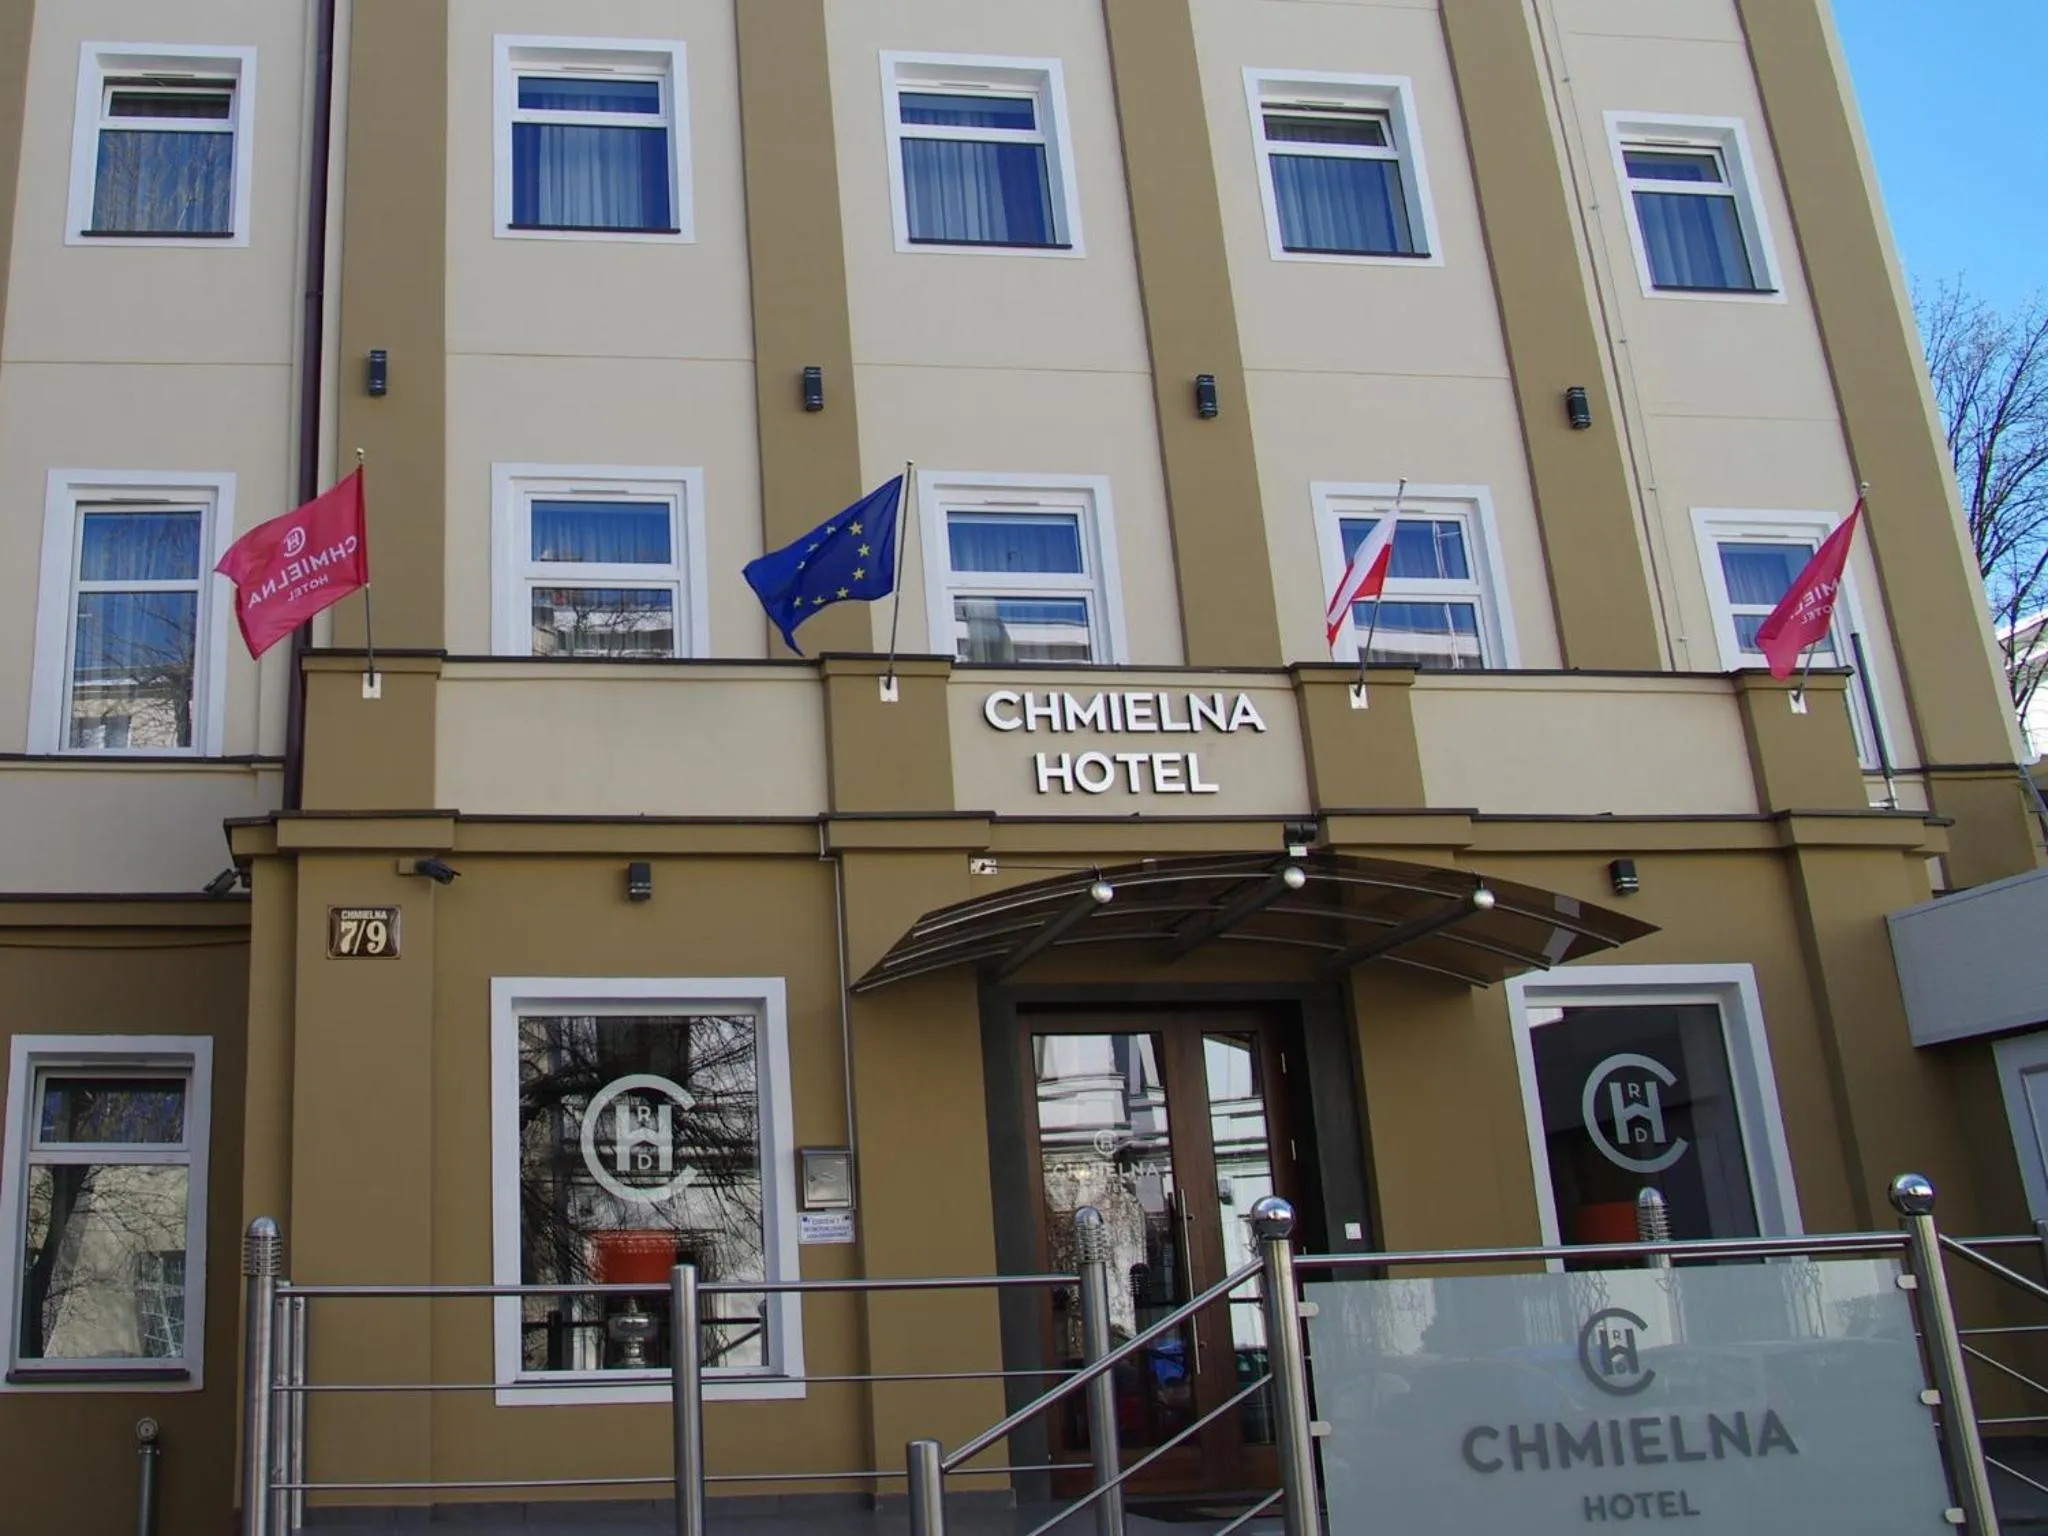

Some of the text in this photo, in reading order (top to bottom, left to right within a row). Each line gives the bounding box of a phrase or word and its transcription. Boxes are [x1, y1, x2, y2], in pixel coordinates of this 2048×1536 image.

[984, 690, 1267, 732] CHMIELNA
[1034, 751, 1220, 794] HOTEL
[340, 920, 387, 954] 7/9
[1461, 1408, 1799, 1474] CHMIELNA
[1582, 1489, 1701, 1523] HOTEL
